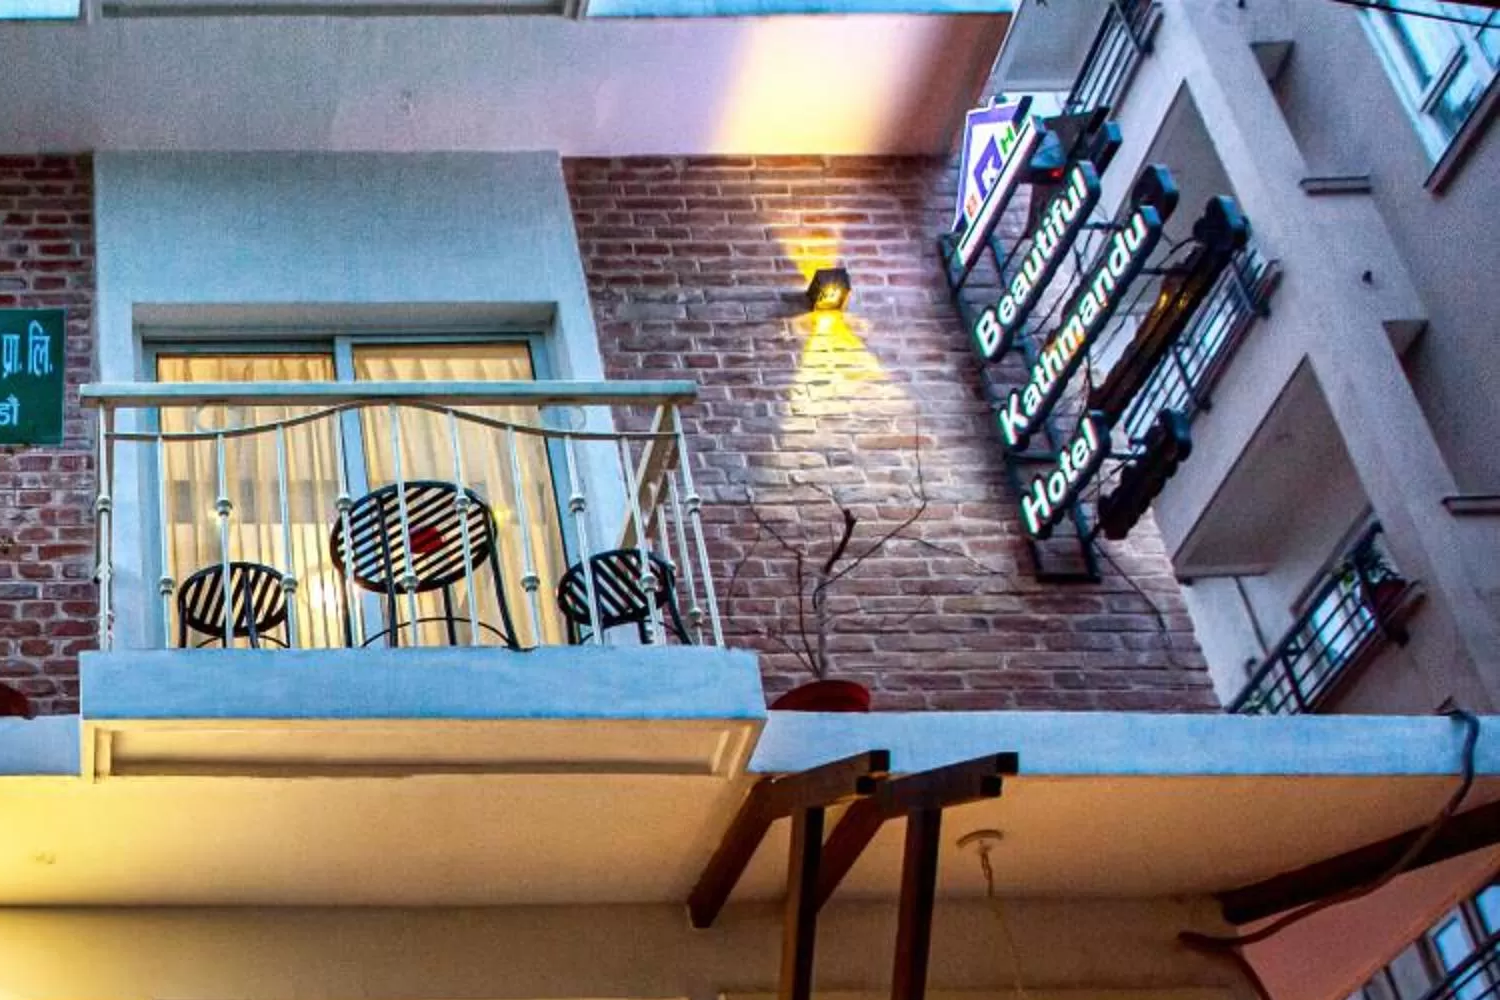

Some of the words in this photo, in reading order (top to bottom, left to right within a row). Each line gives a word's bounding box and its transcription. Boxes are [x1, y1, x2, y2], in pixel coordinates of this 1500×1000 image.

[975, 167, 1090, 358] Beautiful
[1000, 214, 1150, 446] Kathmandu
[1020, 416, 1101, 534] Hotel
